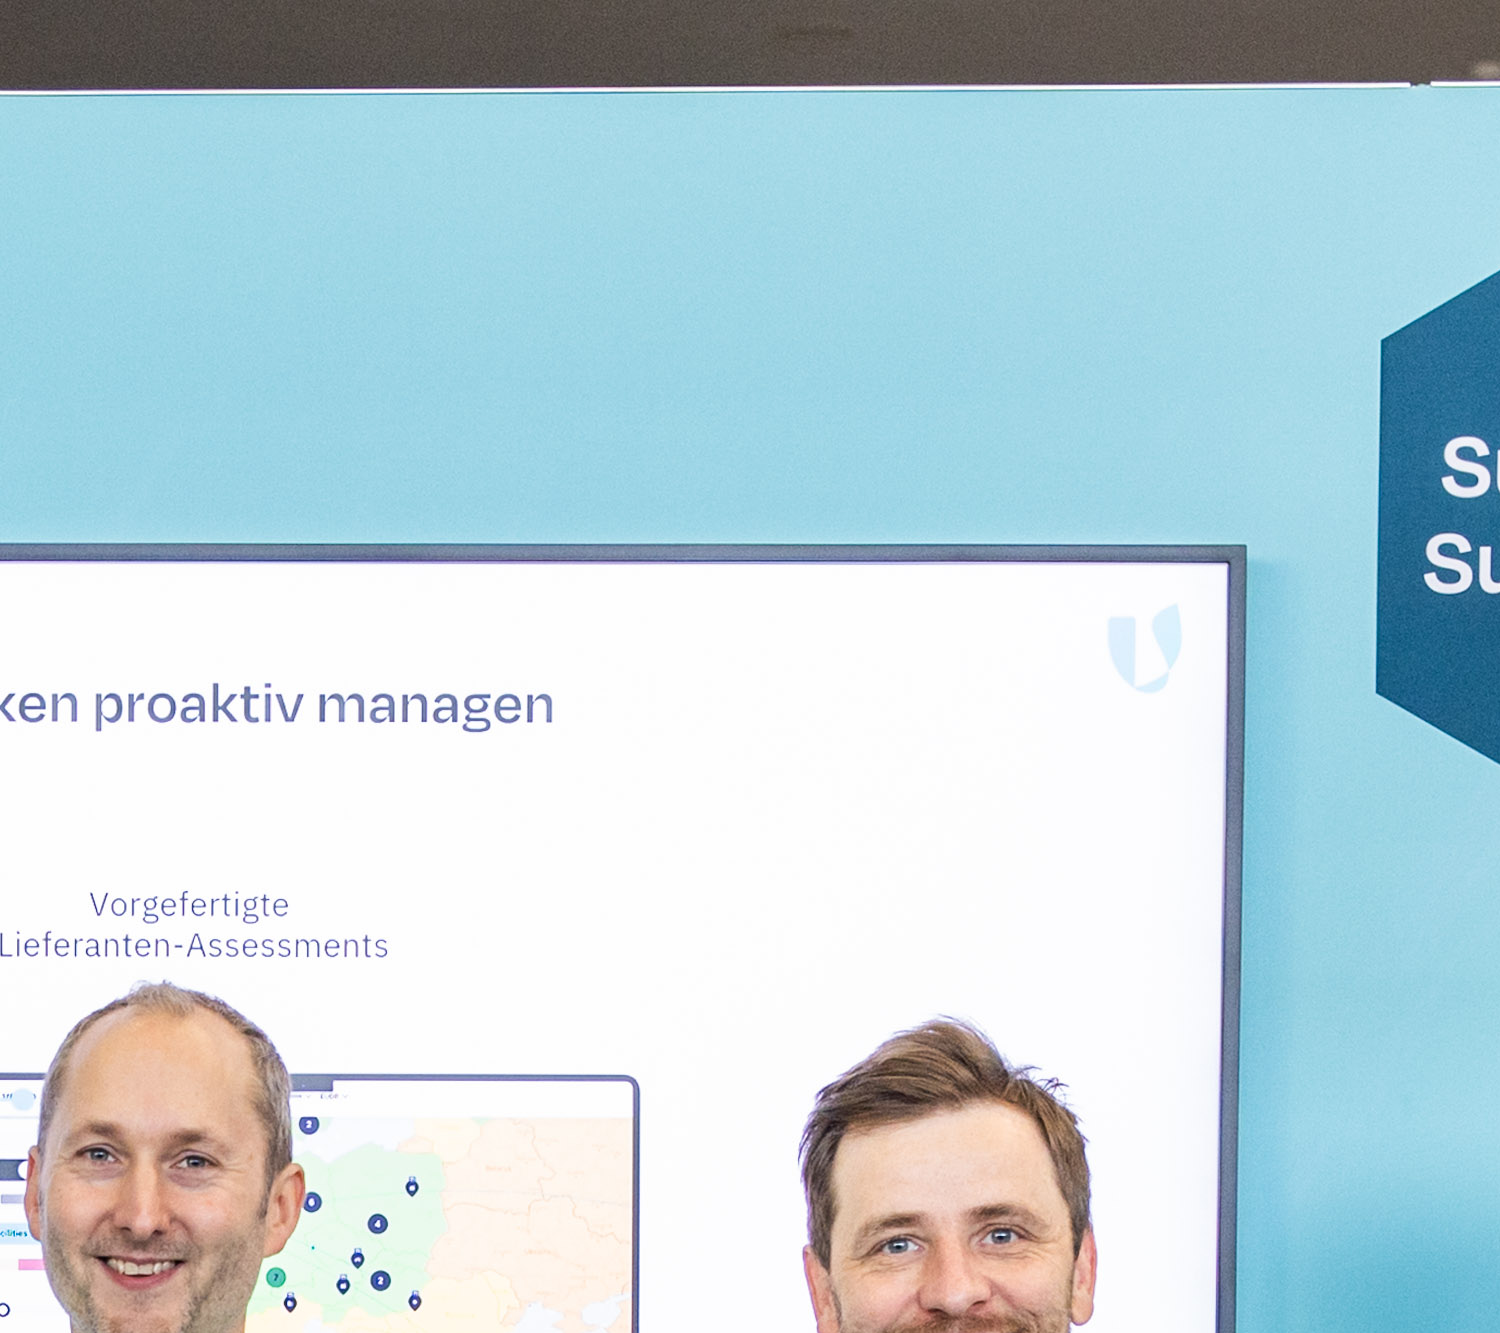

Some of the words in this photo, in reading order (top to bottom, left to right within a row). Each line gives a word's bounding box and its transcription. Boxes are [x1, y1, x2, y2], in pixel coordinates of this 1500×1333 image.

[96, 683, 304, 731] proaktiv
[319, 693, 552, 732] managen
[90, 891, 288, 924] Vorgefertigte
[0, 931, 388, 958] Lieferanten-Assessments
